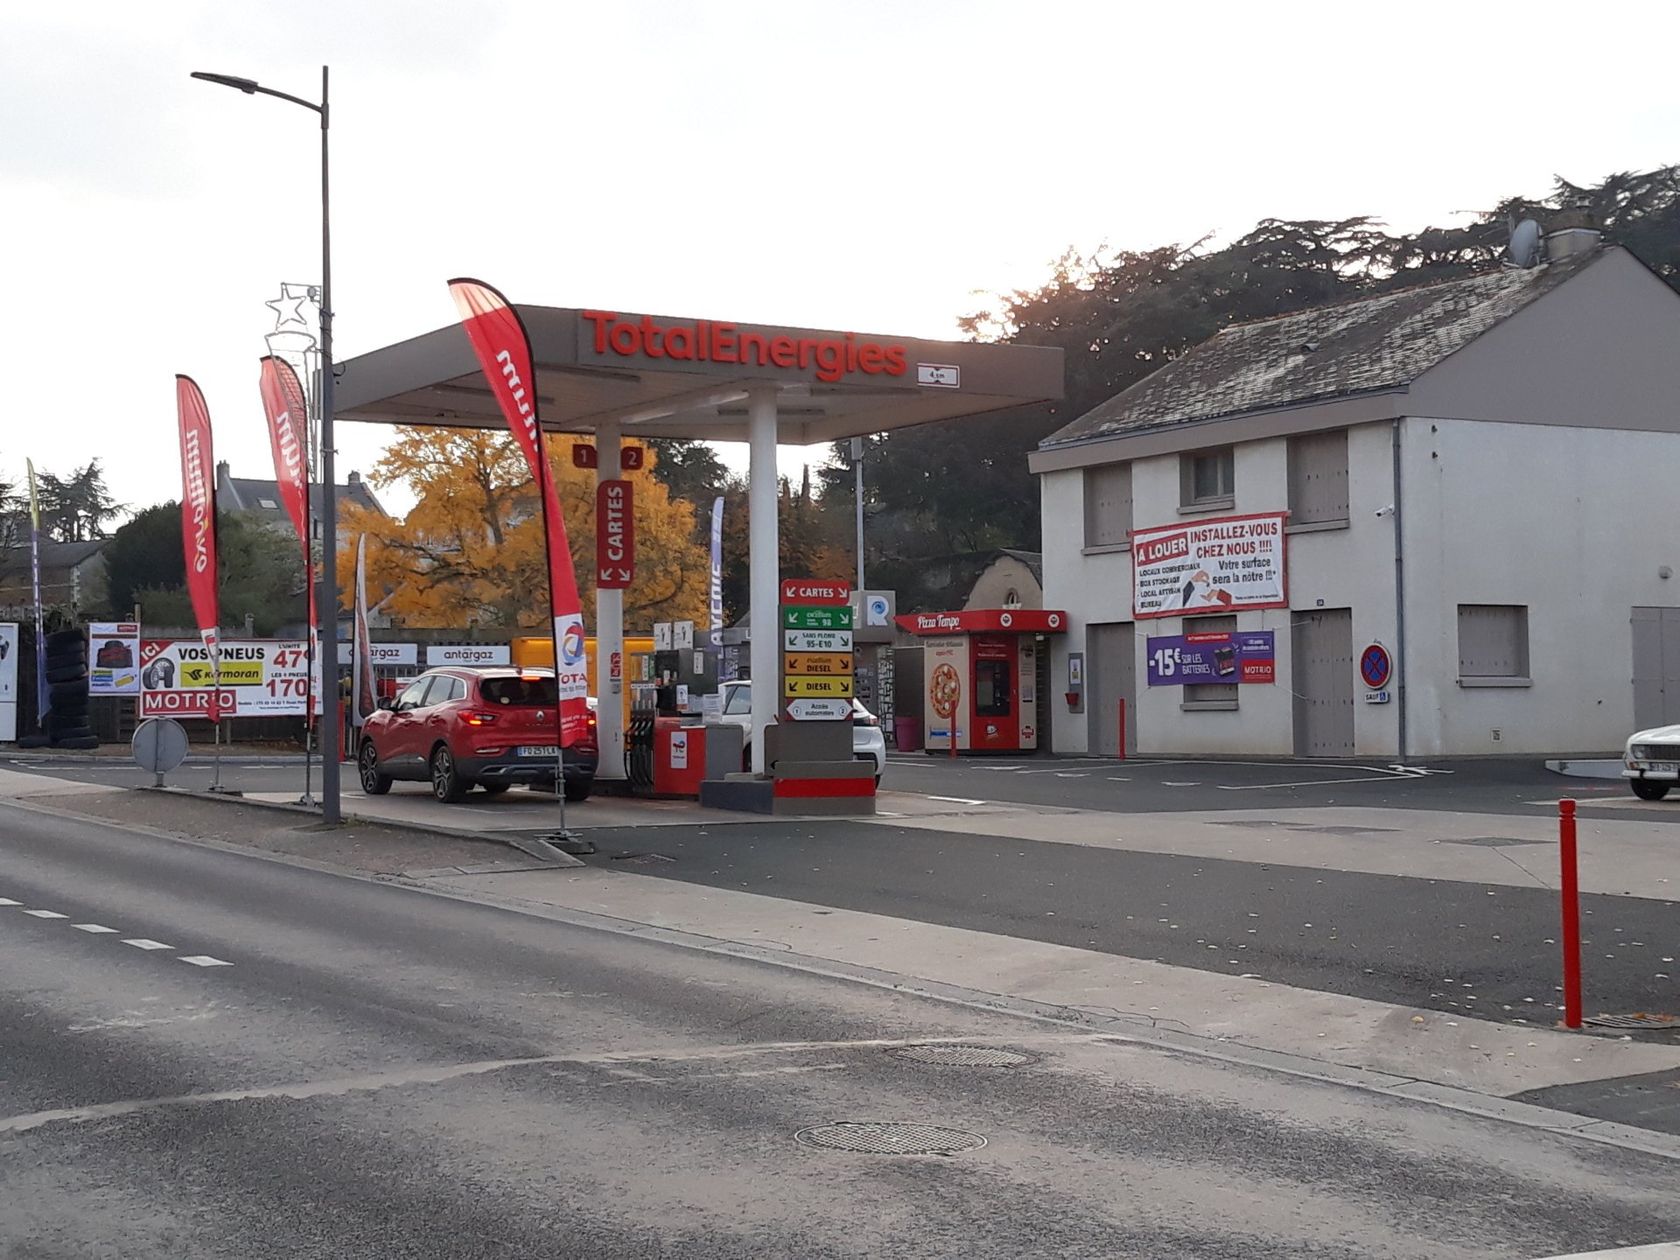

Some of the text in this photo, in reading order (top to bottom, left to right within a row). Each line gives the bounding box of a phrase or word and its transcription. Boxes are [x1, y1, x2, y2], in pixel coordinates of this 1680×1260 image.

[582, 310, 907, 382] TotalEnergies
[580, 449, 588, 462] 1
[628, 451, 638, 465] 2
[608, 486, 623, 561] CARTES
[1190, 522, 1278, 543] INSTALLEZ-VOUS
[1149, 538, 1187, 560] LOUER
[1196, 544, 1224, 559] CHEZ
[1227, 541, 1256, 555] NOUS
[1219, 557, 1271, 570] Votre surface
[1139, 566, 1161, 577] LOCAUX
[1152, 576, 1180, 586] STOCKAGE
[1212, 575, 1231, 584] sera
[1233, 573, 1240, 583] la
[799, 588, 834, 598] CARTES
[1140, 589, 1157, 598] LOCAL
[918, 615, 960, 630] Pizza Tempo
[806, 640, 833, 648] 95-E10
[141, 643, 160, 661] ICI
[178, 648, 208, 660] VOS
[444, 649, 494, 662] antargaz
[806, 664, 831, 672] DIESEL
[1244, 666, 1272, 674] MOTRIO
[806, 683, 832, 691] DIESEL
